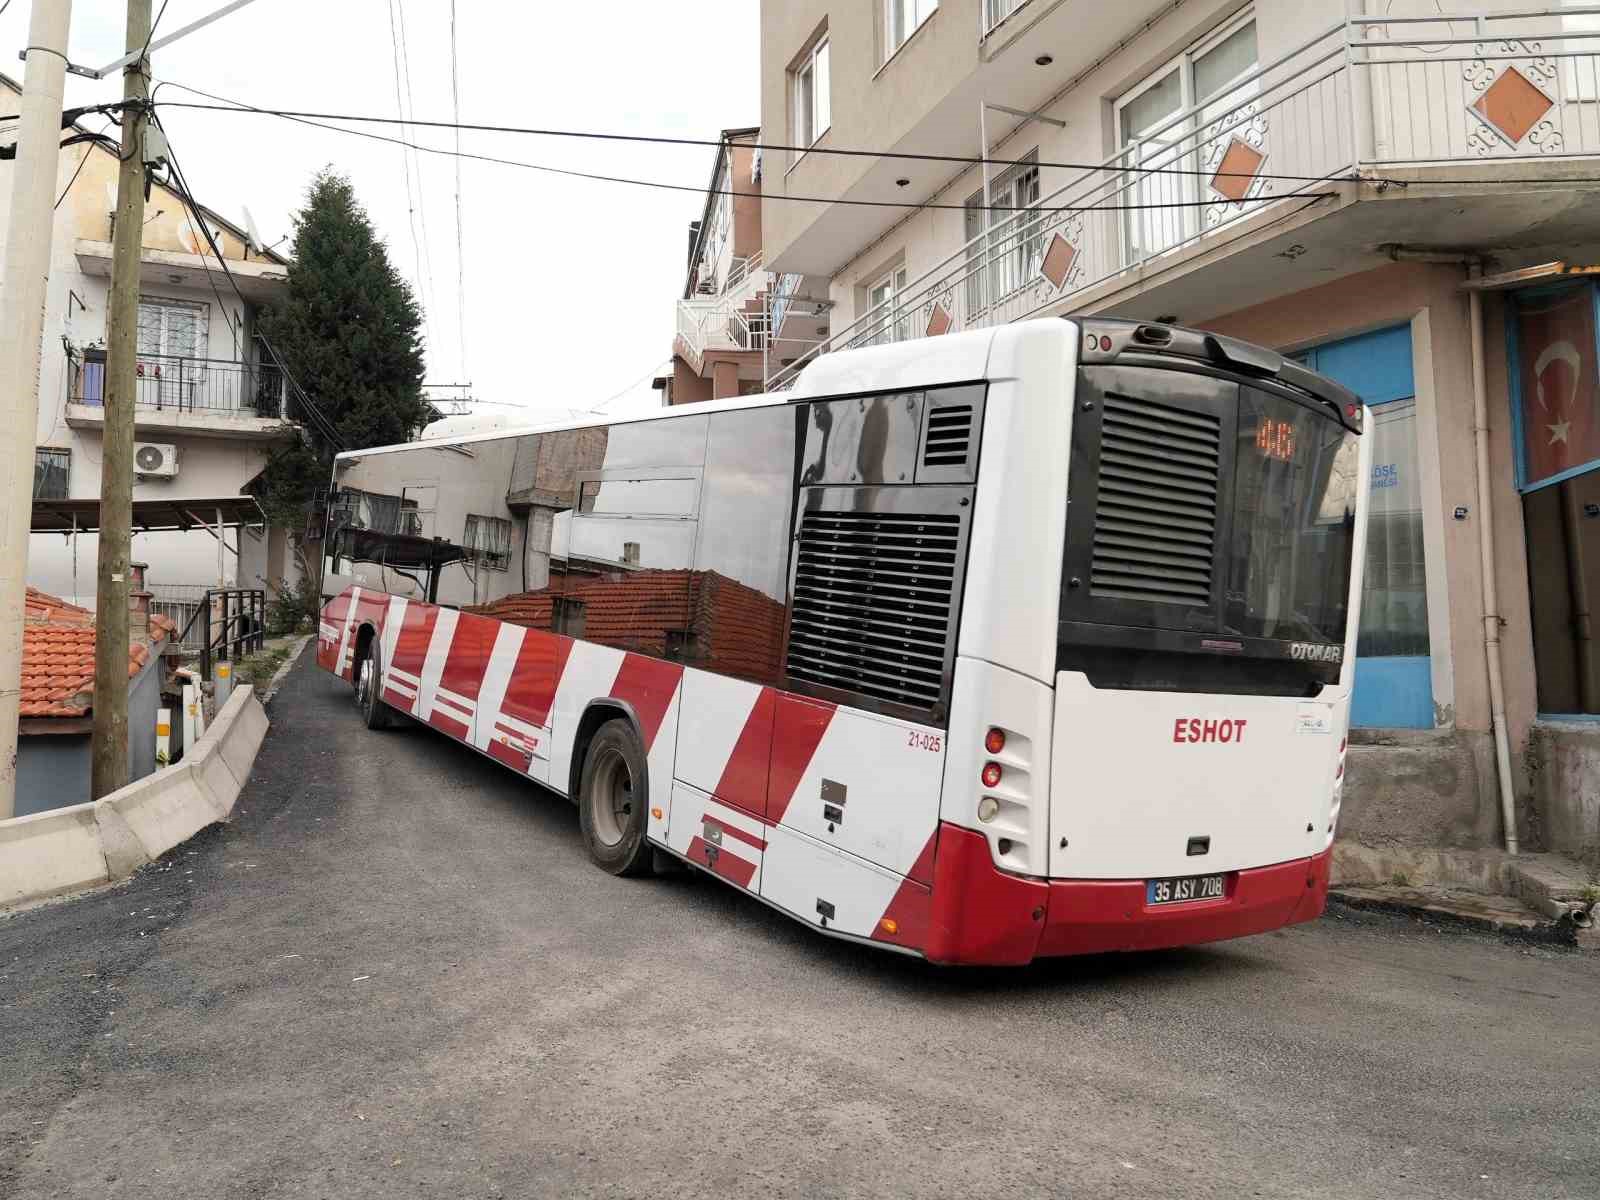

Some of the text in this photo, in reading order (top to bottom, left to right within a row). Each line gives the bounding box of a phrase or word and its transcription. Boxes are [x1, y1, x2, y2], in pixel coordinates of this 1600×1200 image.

[908, 731, 941, 752] 21-025
[1174, 718, 1247, 743] ESHOT
[1154, 877, 1223, 901] 35 ASY 708
